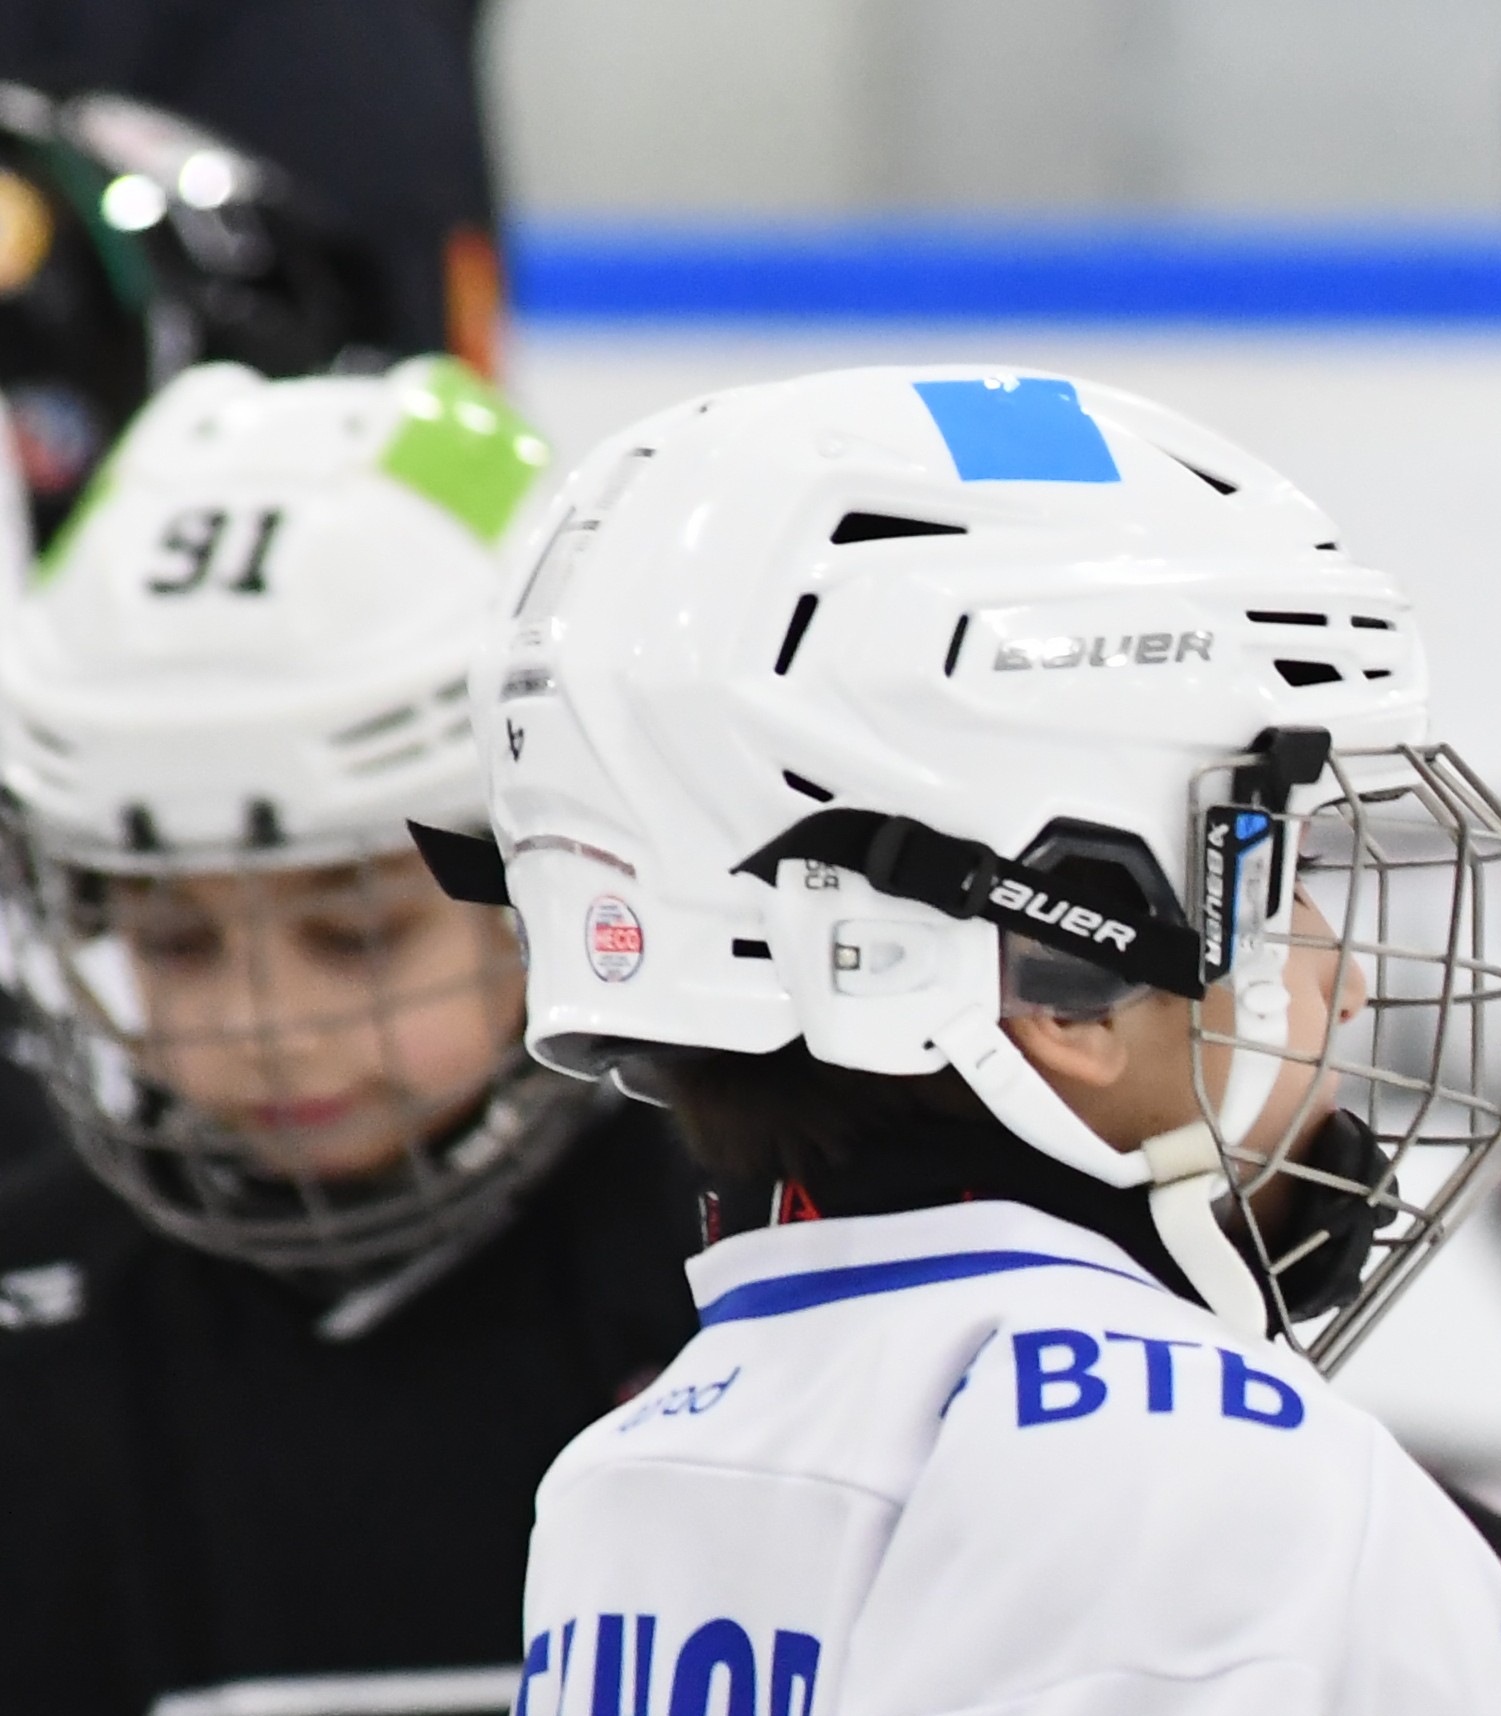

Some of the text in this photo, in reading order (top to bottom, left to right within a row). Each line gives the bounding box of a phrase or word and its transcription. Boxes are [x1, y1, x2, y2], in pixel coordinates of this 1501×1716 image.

[147, 504, 286, 598] 91
[993, 629, 1214, 672] BAUER
[960, 870, 1138, 953] AUER
